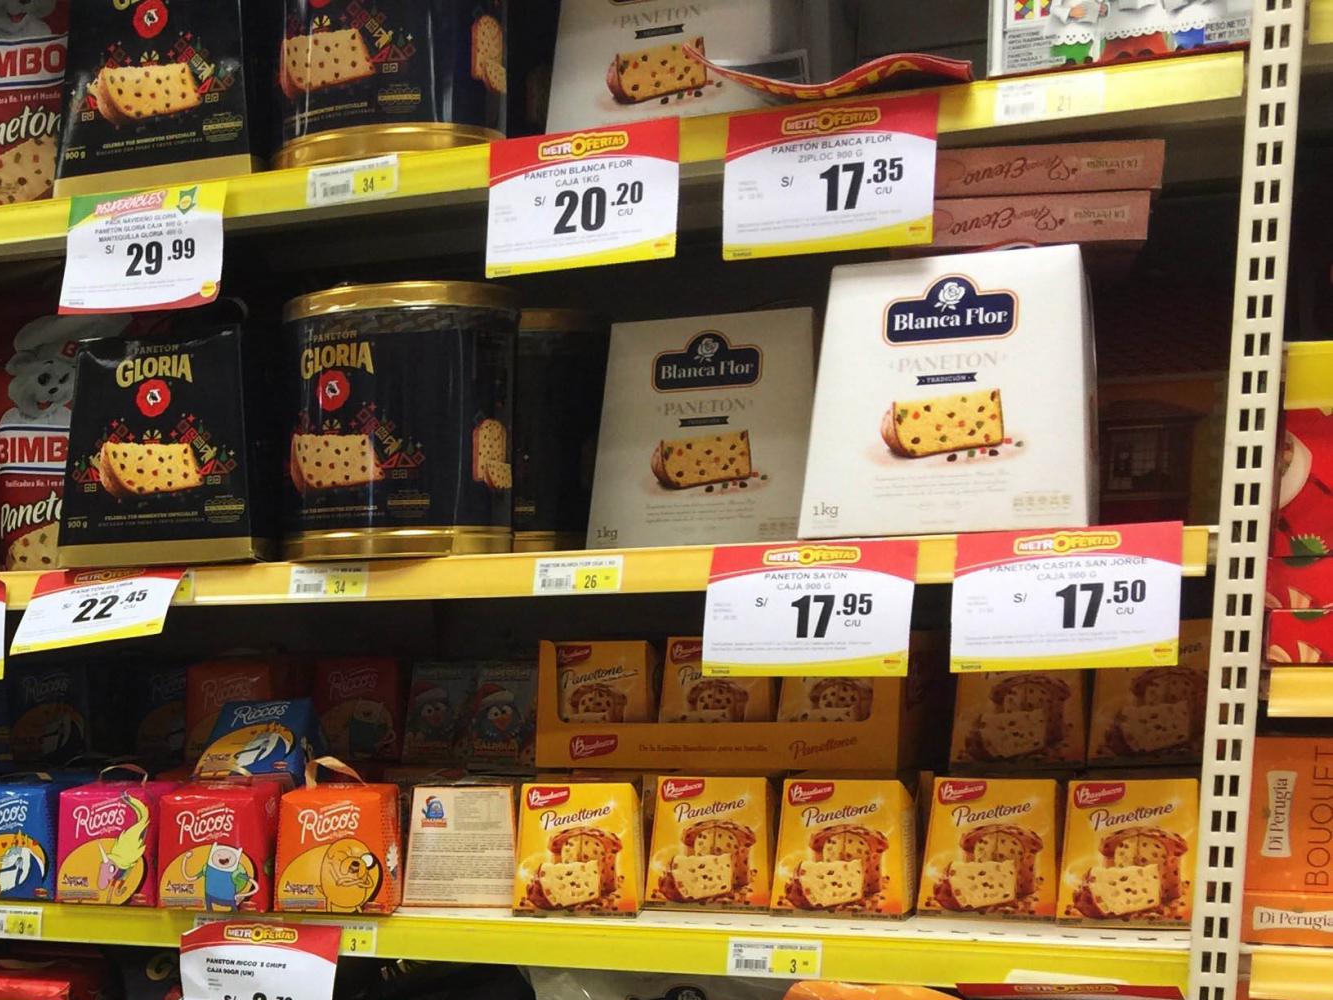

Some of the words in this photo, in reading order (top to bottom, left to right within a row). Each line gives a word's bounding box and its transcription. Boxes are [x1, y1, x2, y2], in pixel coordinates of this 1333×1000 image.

[818, 137, 857, 150] BLANCA
[862, 134, 891, 145] FLOR
[566, 163, 600, 176] BLANCA
[604, 159, 632, 170] FLOR
[781, 175, 794, 187] S/
[821, 158, 903, 211] 17.35
[875, 186, 892, 196] C/U
[534, 195, 546, 206] S/
[554, 182, 643, 234] 20.20
[617, 207, 633, 217] C/U
[126, 239, 196, 276] 29.99
[893, 310, 961, 331] Blanca
[966, 306, 1008, 328] Flor
[116, 354, 193, 388] GLORIA
[301, 342, 374, 380] GLORIA
[661, 363, 715, 381] Blanca
[719, 359, 754, 375] Flor
[1043, 559, 1081, 570] CASITA
[1083, 558, 1106, 568] SAN
[1110, 556, 1148, 567] JORGE
[71, 588, 146, 624] 22.45
[755, 597, 768, 608] S/
[791, 593, 872, 639] 17.95
[844, 617, 861, 628] C/U
[1013, 592, 1027, 604] S/
[1055, 579, 1147, 629] 17.50
[1116, 605, 1135, 616] C/U
[540, 805, 611, 832] Panettone
[674, 798, 746, 823] Panettone
[802, 803, 879, 829] Panettone
[952, 801, 1032, 827] Panettone
[1090, 802, 1174, 832] Panettone
[1269, 777, 1292, 834] Perugia
[1260, 911, 1279, 925] Di
